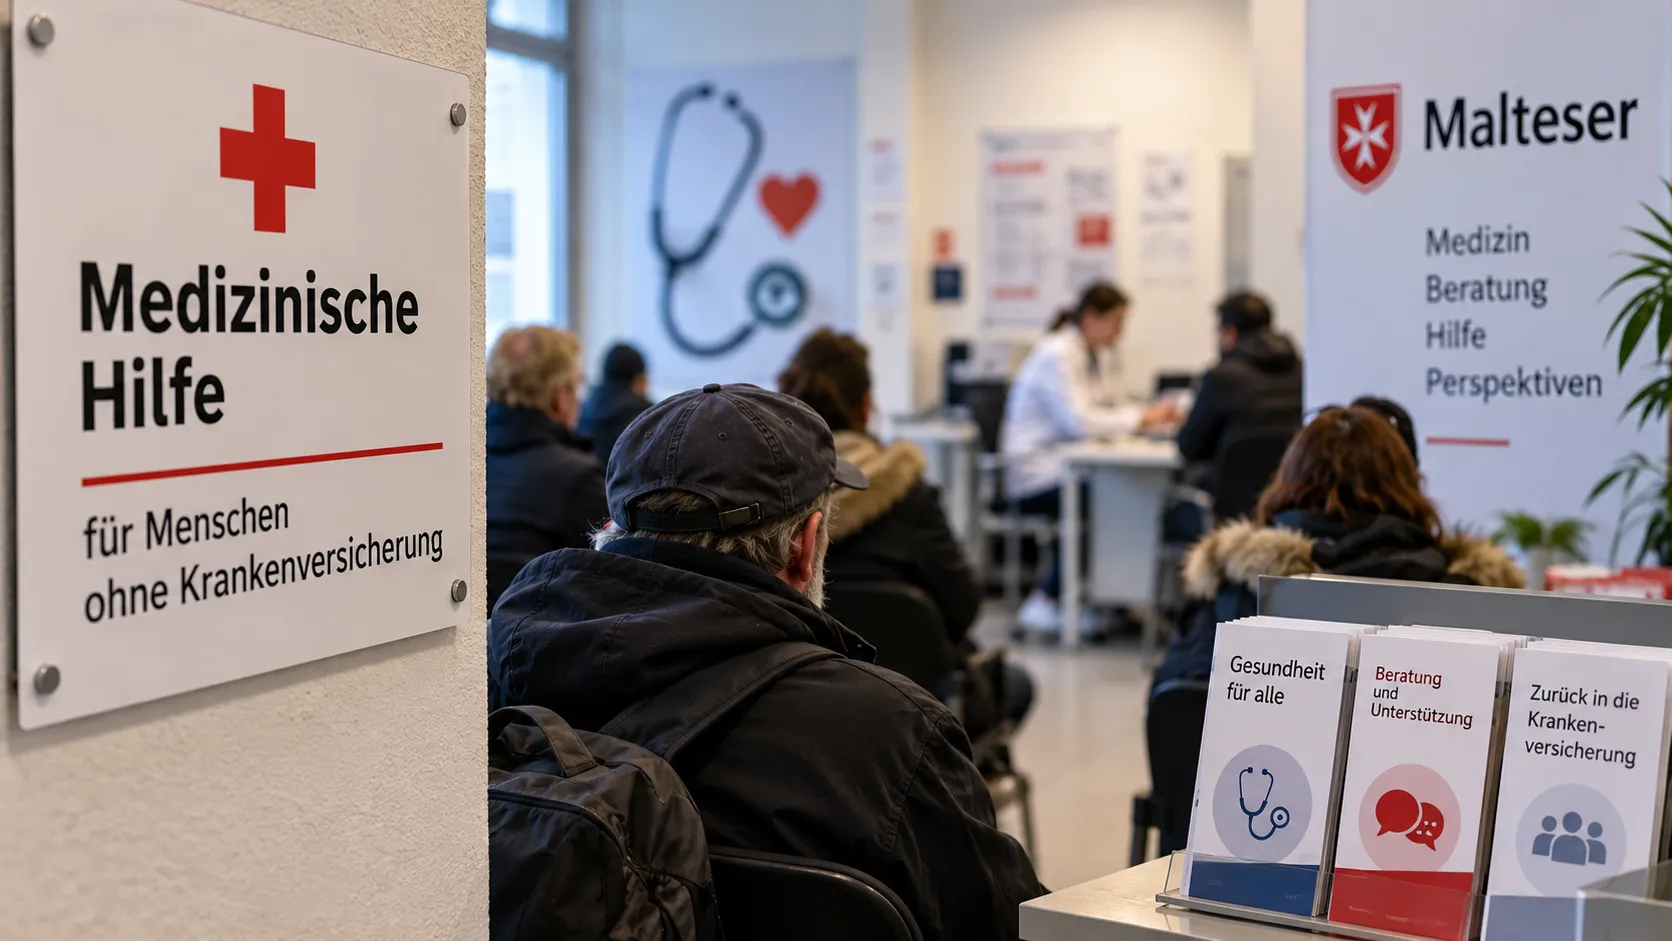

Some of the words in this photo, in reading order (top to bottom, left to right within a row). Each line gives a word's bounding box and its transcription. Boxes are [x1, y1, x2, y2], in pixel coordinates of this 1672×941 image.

[1426, 92, 1637, 150] Malteser
[1427, 225, 1529, 256] Medizin
[81, 262, 418, 334] Medizinische
[1427, 275, 1547, 309] Beratung
[1427, 319, 1486, 349] Hilfe
[82, 356, 224, 431] Hilfe
[1427, 367, 1602, 403] Perspektiven
[84, 516, 133, 559] für
[147, 497, 289, 549] Menschen
[84, 579, 169, 624] ohne
[181, 528, 443, 604] Krankenversicherung
[1230, 656, 1326, 681] Gesundheit
[1374, 666, 1442, 688] Beratung
[1228, 682, 1251, 701] für
[1255, 685, 1284, 704] alle
[1374, 687, 1398, 699] und
[1530, 684, 1587, 705] Zurück
[1593, 690, 1607, 706] in
[1613, 692, 1639, 709] die
[1371, 703, 1473, 729] Unterstützung
[1528, 711, 1604, 733] Kranken-
[1526, 740, 1636, 769] versicherung
